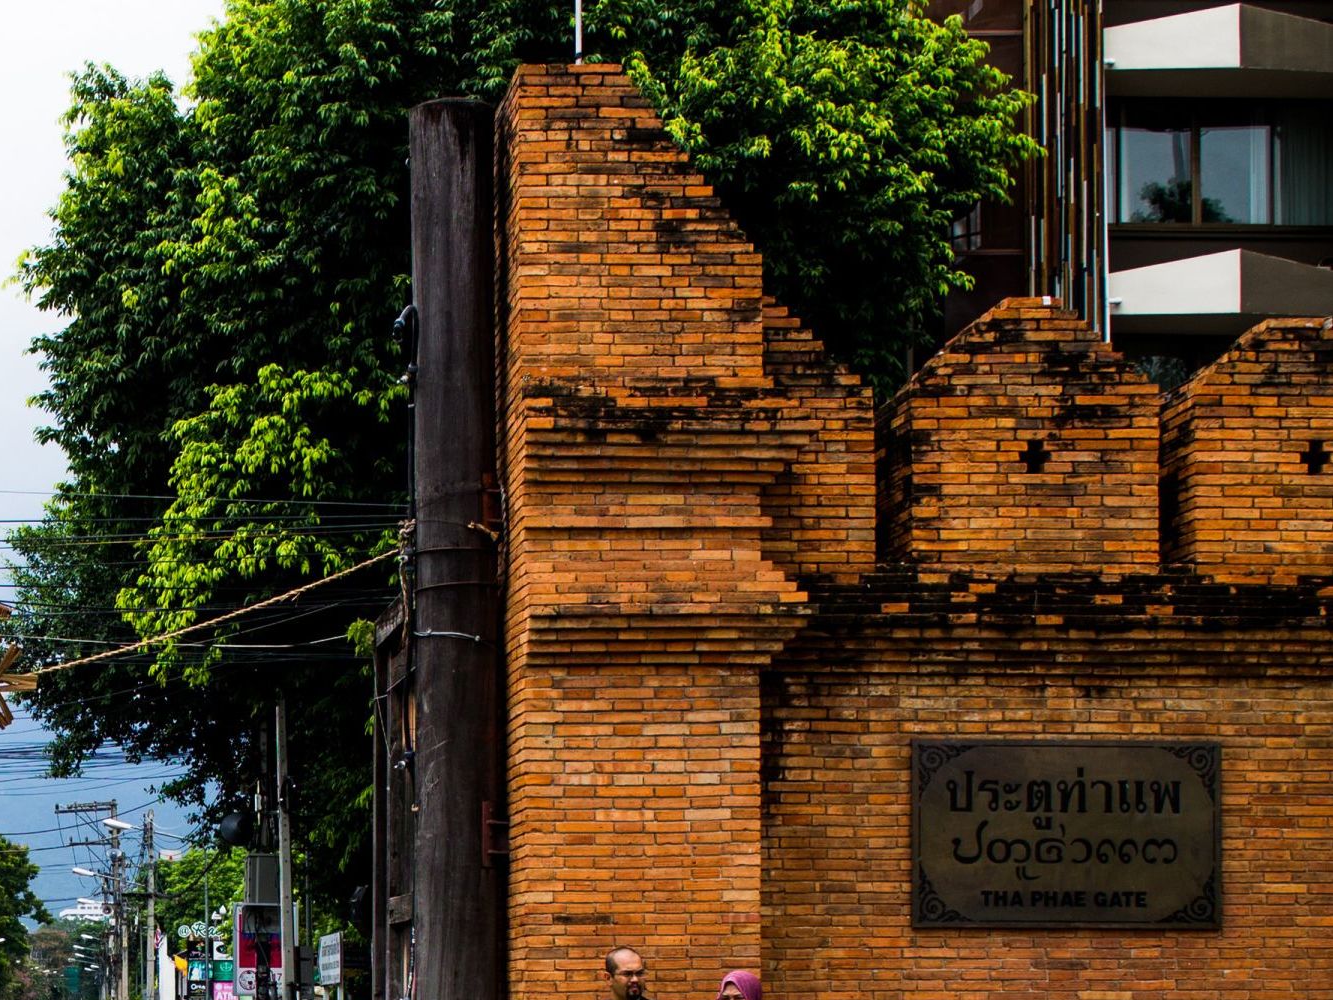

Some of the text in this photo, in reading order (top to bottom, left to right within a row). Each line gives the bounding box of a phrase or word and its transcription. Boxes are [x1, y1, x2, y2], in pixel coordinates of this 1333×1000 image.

[946, 767, 1181, 830] ประตูท่าแพ
[981, 890, 1148, 908] THA PHAE GATE
